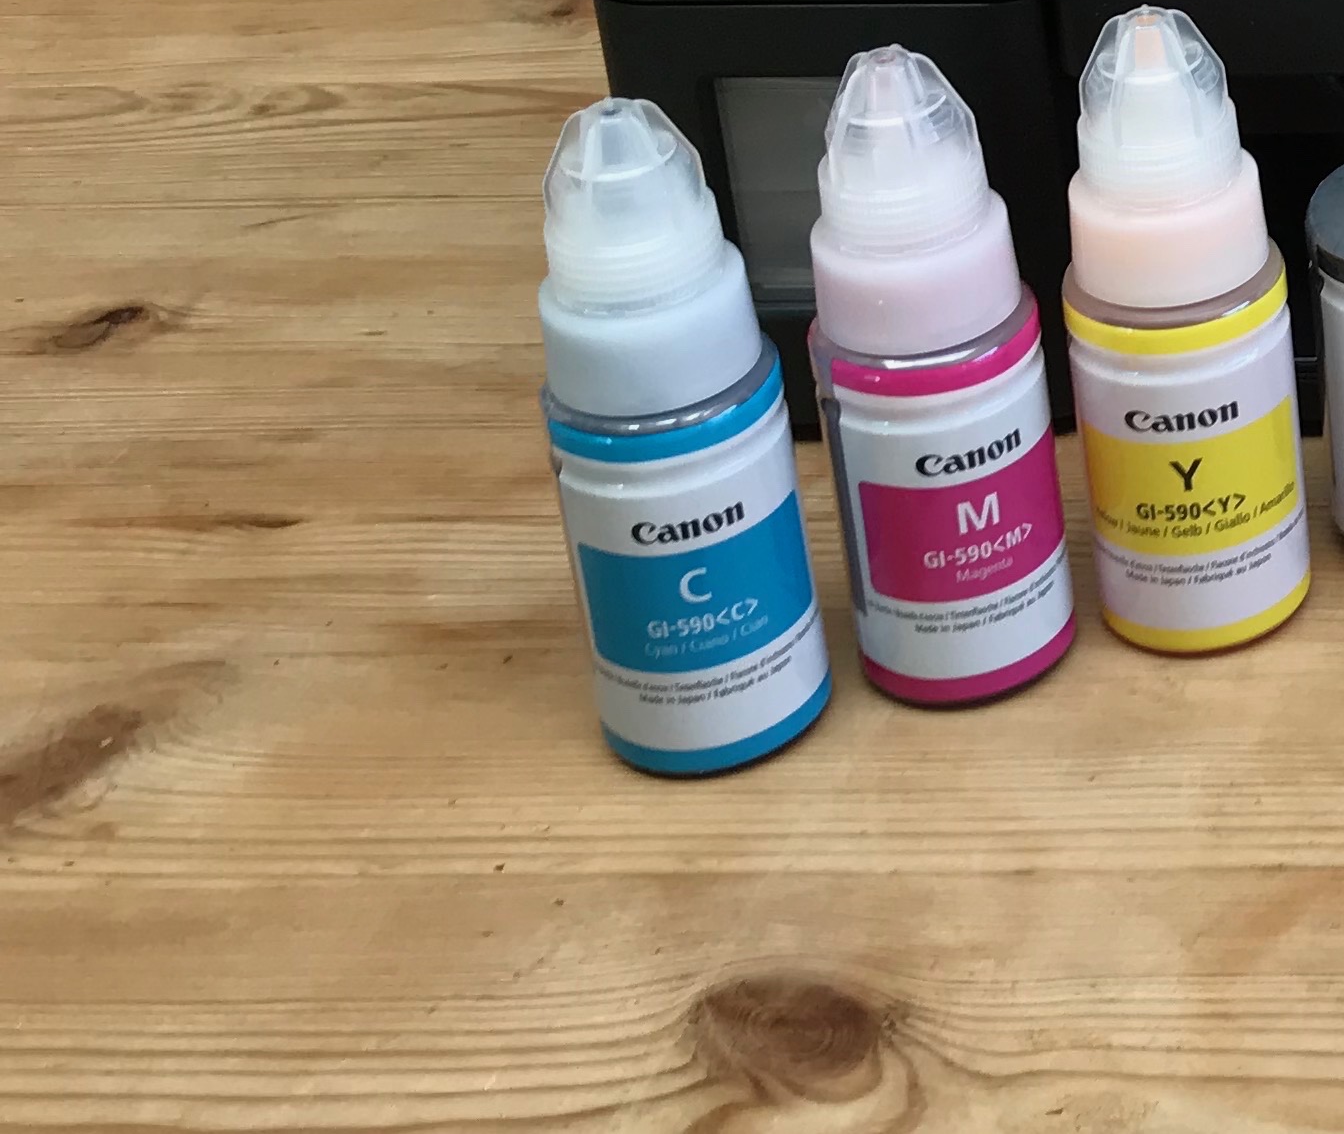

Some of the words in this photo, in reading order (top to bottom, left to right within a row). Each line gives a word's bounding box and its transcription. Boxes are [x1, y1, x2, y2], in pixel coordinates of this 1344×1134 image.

[1124, 401, 1239, 433] Canon
[915, 427, 1022, 478] Canon
[1169, 457, 1203, 492] Y
[632, 501, 746, 546] Canon
[956, 491, 1000, 536] M
[1136, 493, 1246, 521] GI-590<Y>
[1126, 521, 1161, 538] Jaune
[1171, 523, 1203, 539] Gelb
[1214, 511, 1251, 533] Giallo
[923, 522, 1033, 569] GI-590<M>
[679, 567, 712, 604] C
[956, 557, 1014, 583] Magenta
[1126, 568, 1149, 583] Made
[1160, 575, 1186, 587] Japan
[647, 597, 759, 640] GI-590<C>
[645, 642, 678, 660] Cyan
[639, 692, 664, 705] Made
[678, 692, 705, 706] Japan
